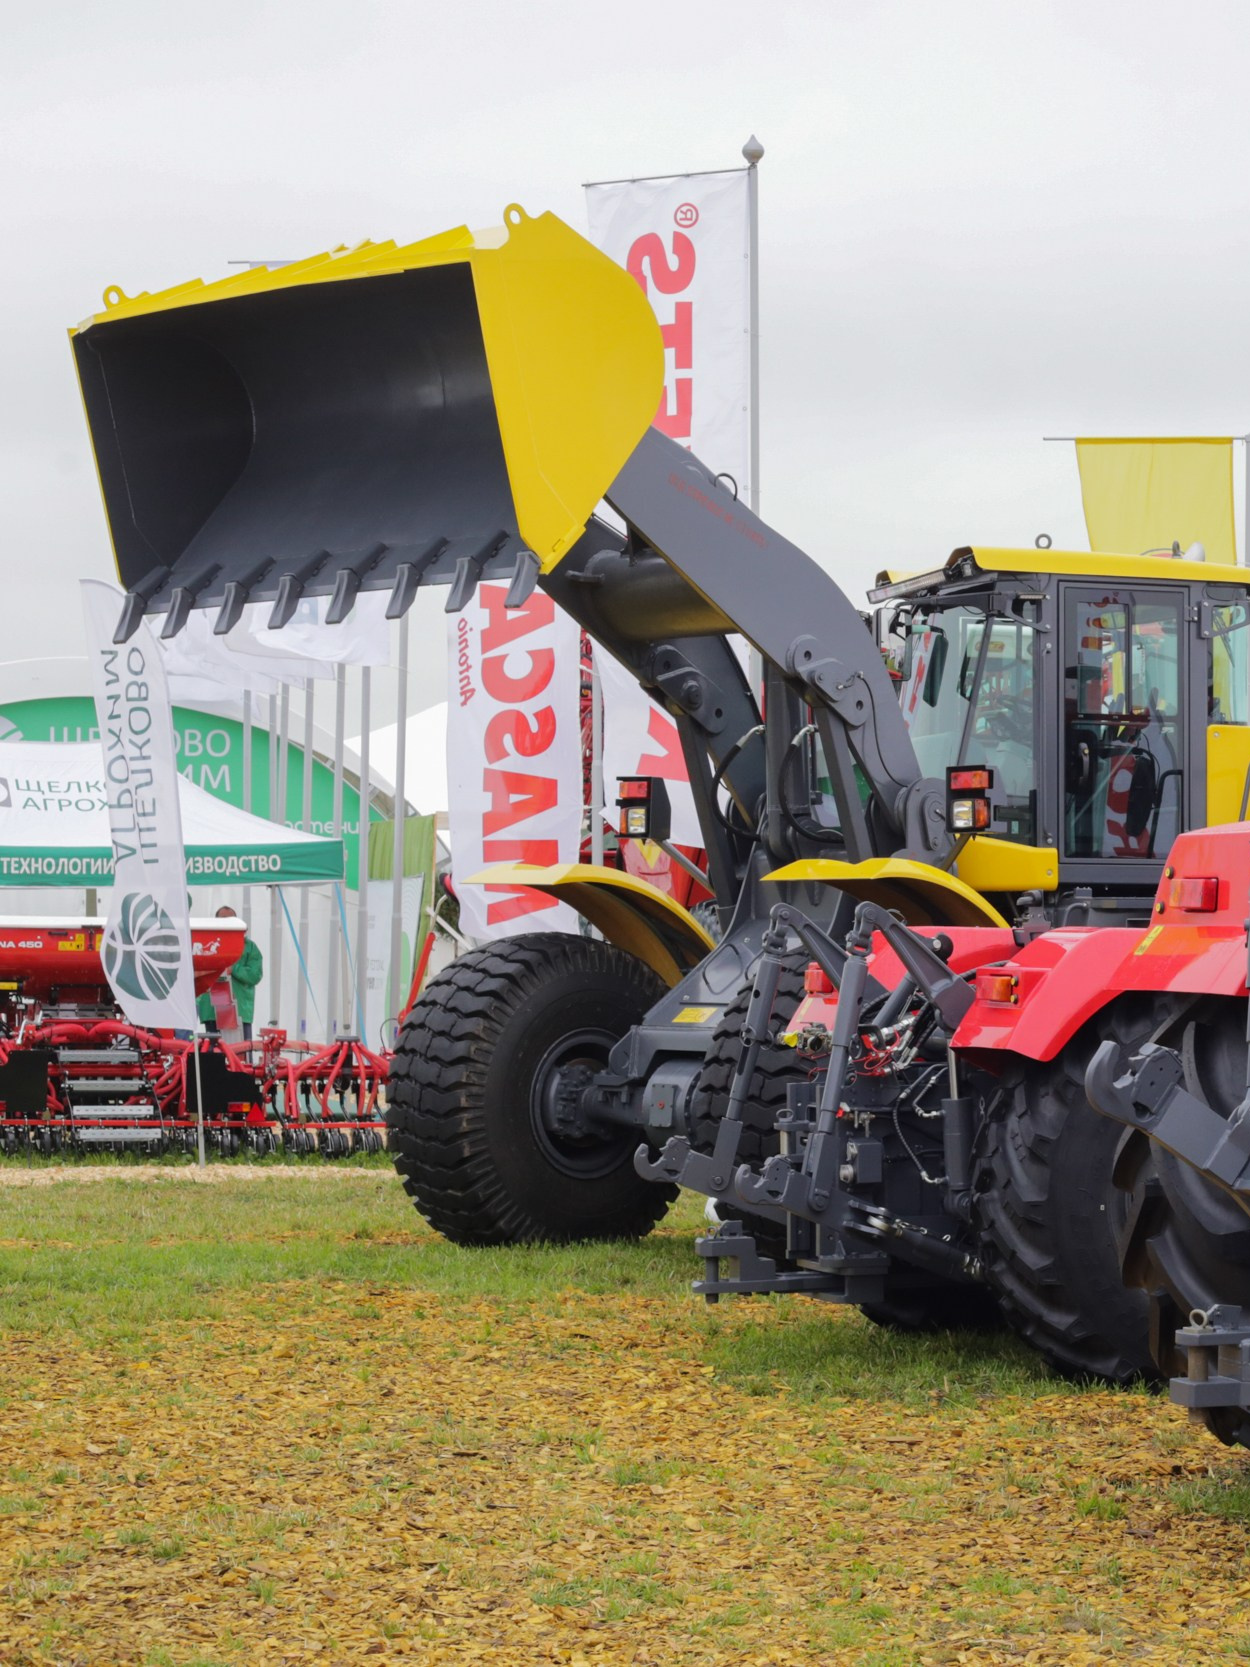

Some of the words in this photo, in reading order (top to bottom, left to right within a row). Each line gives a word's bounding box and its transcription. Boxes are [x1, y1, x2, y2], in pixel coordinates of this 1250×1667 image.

[15, 778, 106, 795] ЩЕЛК
[22, 797, 110, 812] АГРОХ
[1, 857, 115, 875] ТЕХНОЛОГИИ
[185, 854, 281, 876] ИЗВОДСТВО
[17, 940, 43, 949] 450
